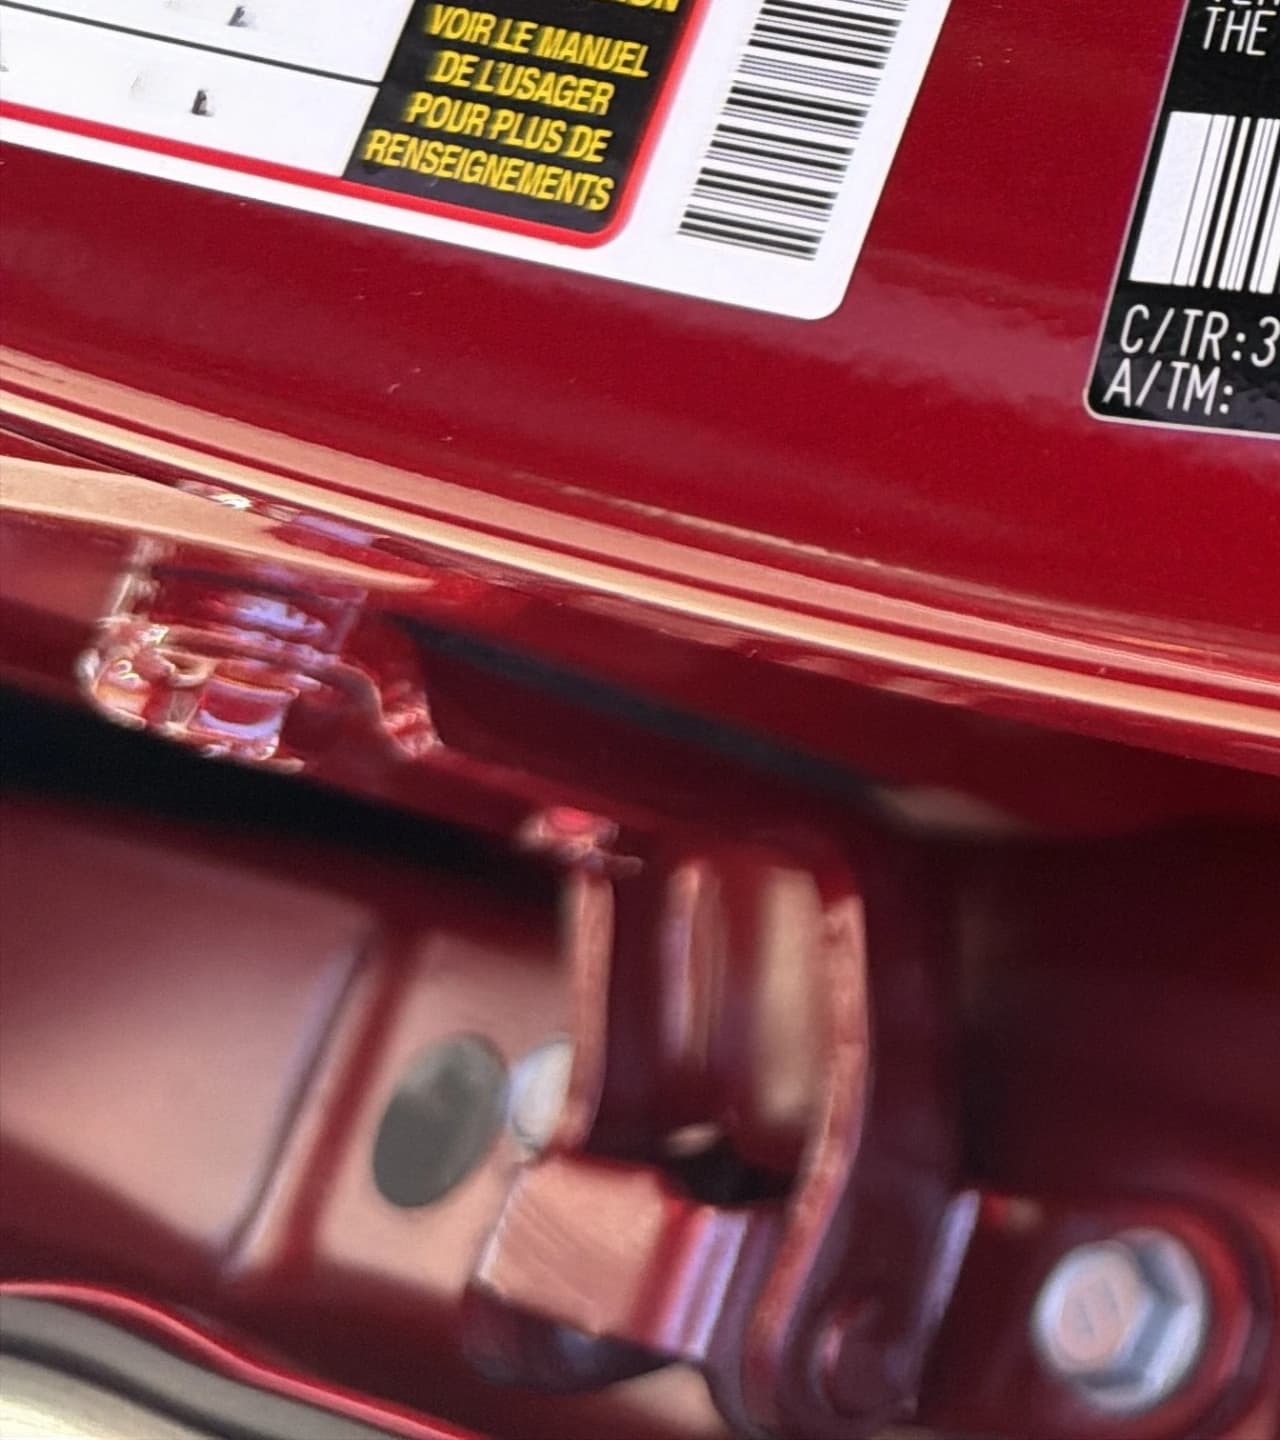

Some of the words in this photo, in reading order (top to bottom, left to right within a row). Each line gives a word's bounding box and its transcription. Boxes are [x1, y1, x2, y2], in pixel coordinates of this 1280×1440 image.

[427, 4, 496, 43] VOIR
[498, 19, 536, 50] LE
[538, 30, 649, 78] MANUEL
[1202, 6, 1277, 56] THE
[431, 51, 471, 86] DE
[478, 59, 615, 115] L'USAGER
[407, 92, 490, 135] POUR
[492, 108, 563, 149] PLUS
[566, 124, 612, 163] DE
[365, 129, 615, 211] RENSEIGNEMENTS
[1102, 359, 1234, 416] A/TM:
